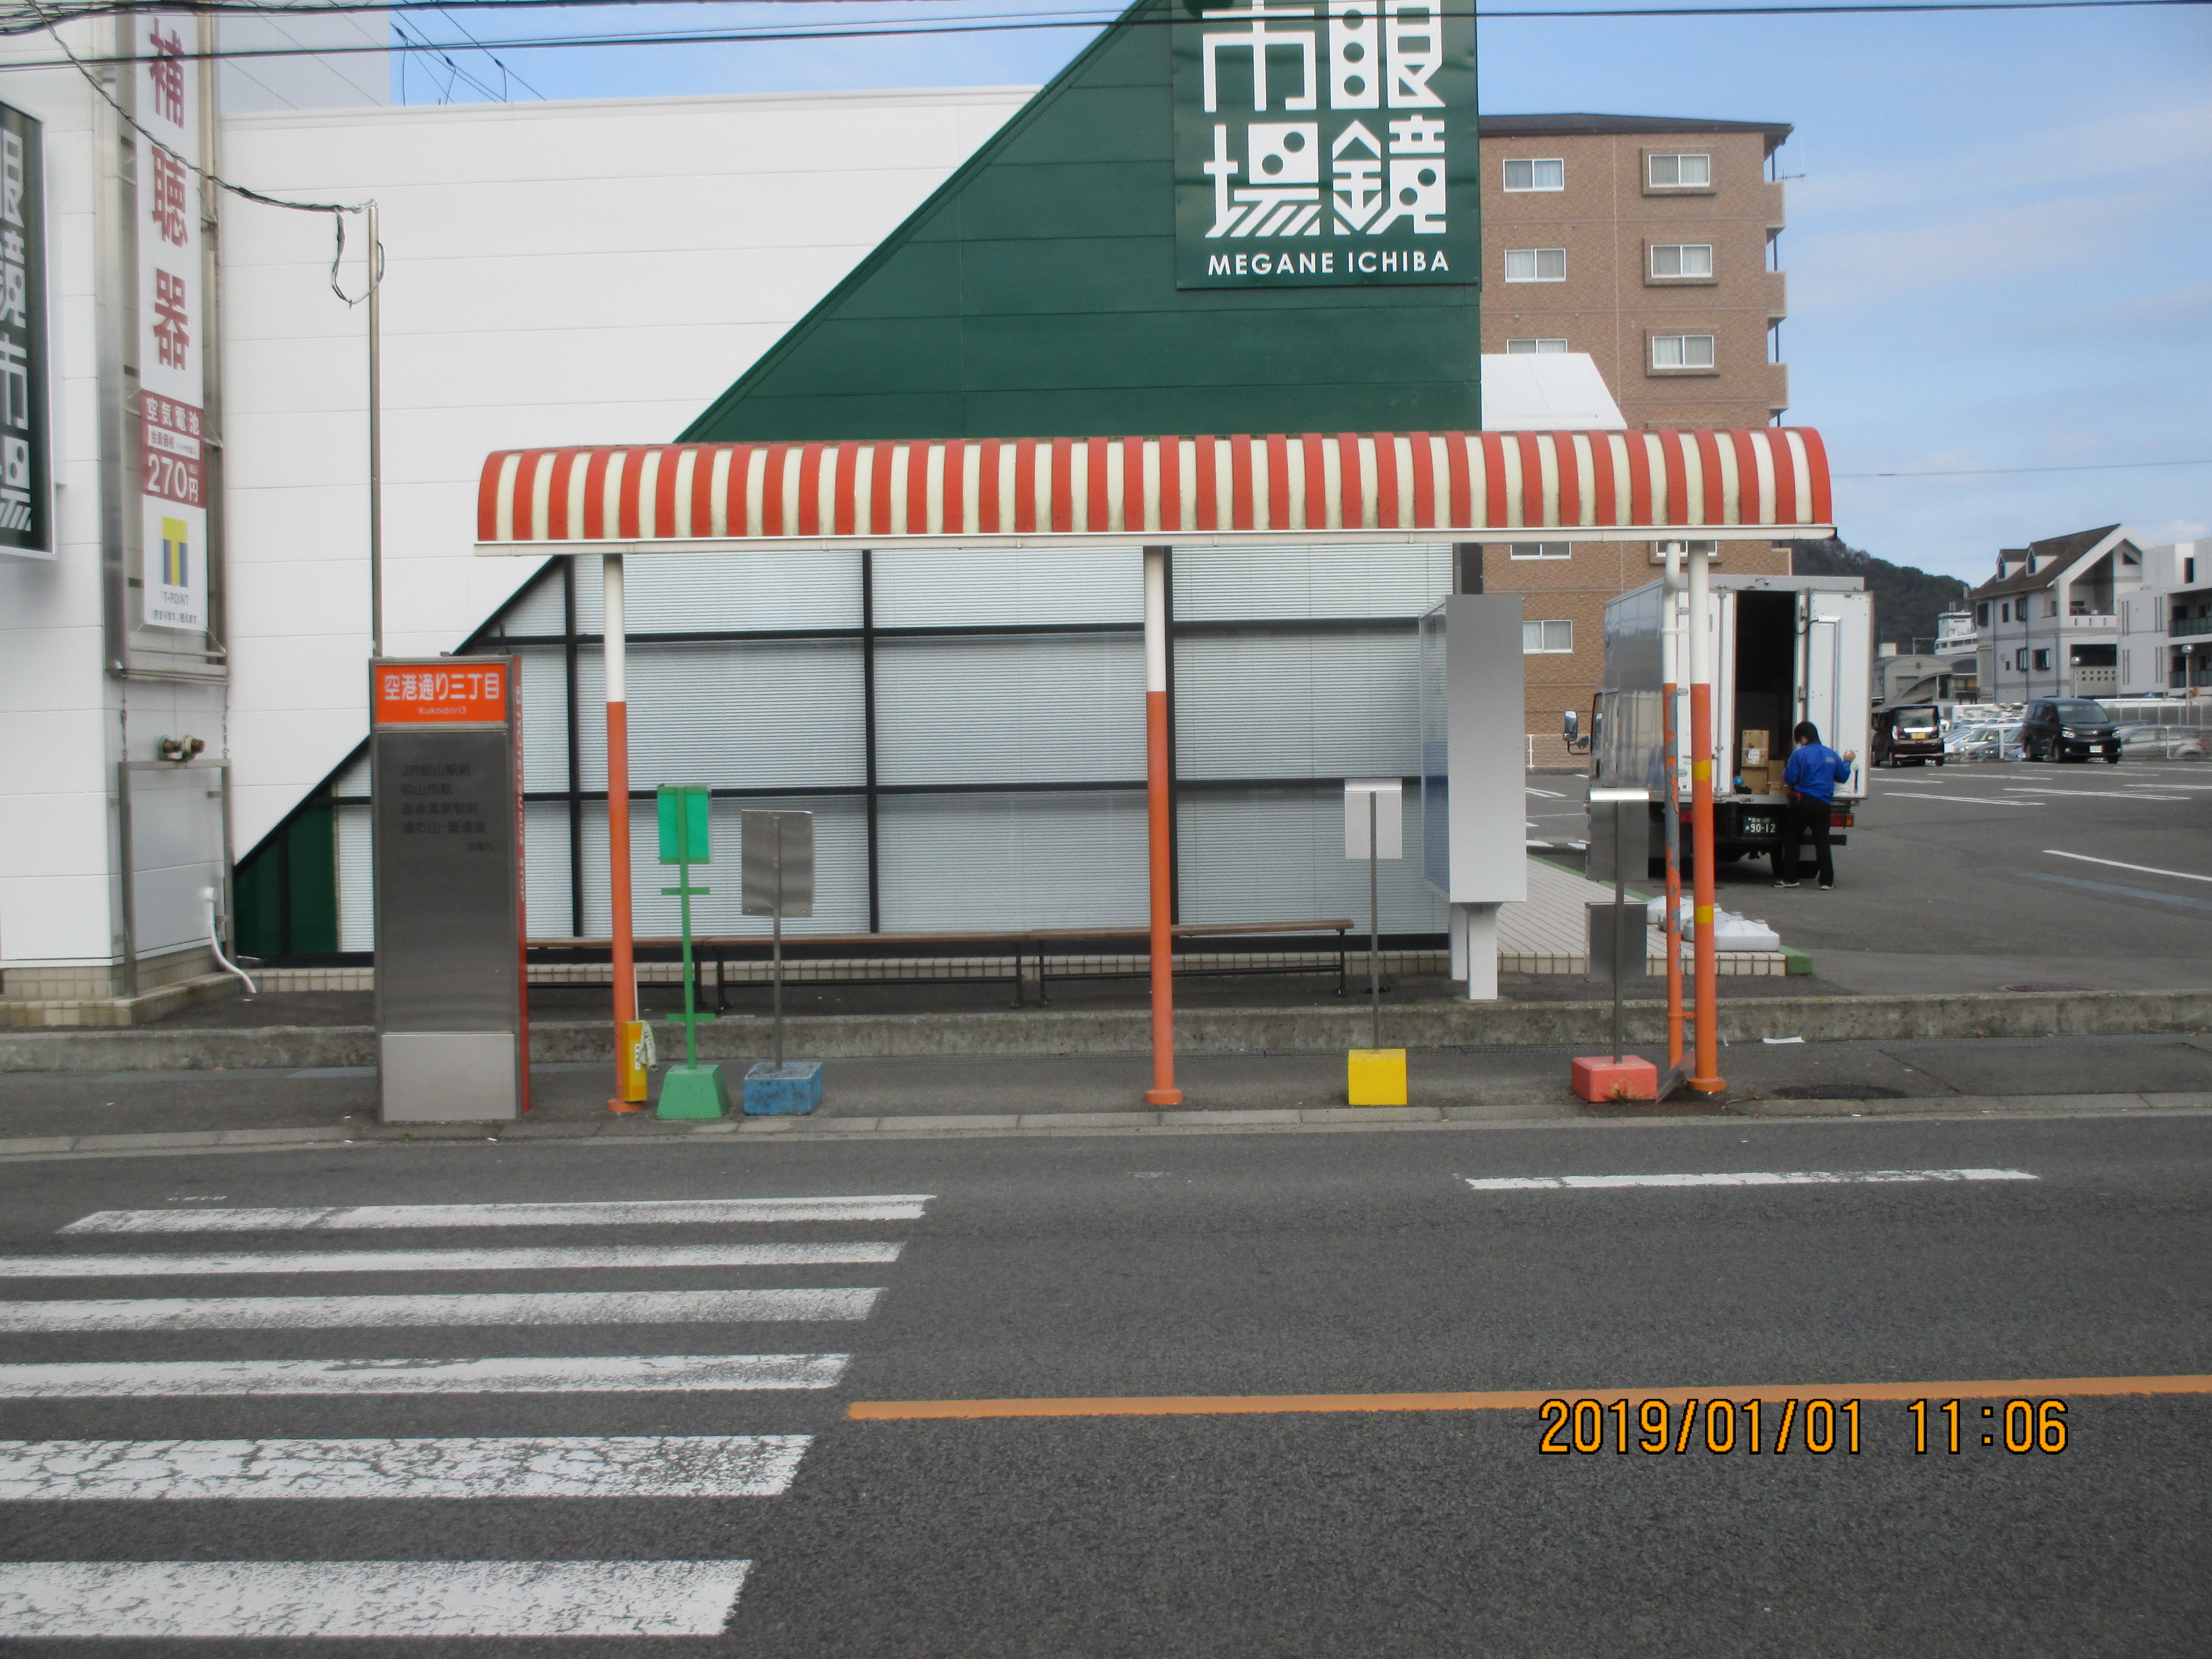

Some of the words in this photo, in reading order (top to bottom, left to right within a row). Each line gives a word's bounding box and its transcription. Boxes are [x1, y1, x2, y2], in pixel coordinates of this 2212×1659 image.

[150, 17, 191, 371] 補聴器
[1208, 252, 1334, 276] MEGANE
[1347, 250, 1450, 273] ICHIBA
[147, 397, 200, 436] 空気電池
[148, 454, 199, 502] 270円
[163, 591, 189, 605] T-POINT
[385, 673, 500, 700] 空港通り三丁目
[418, 706, 467, 714] Kukodori3
